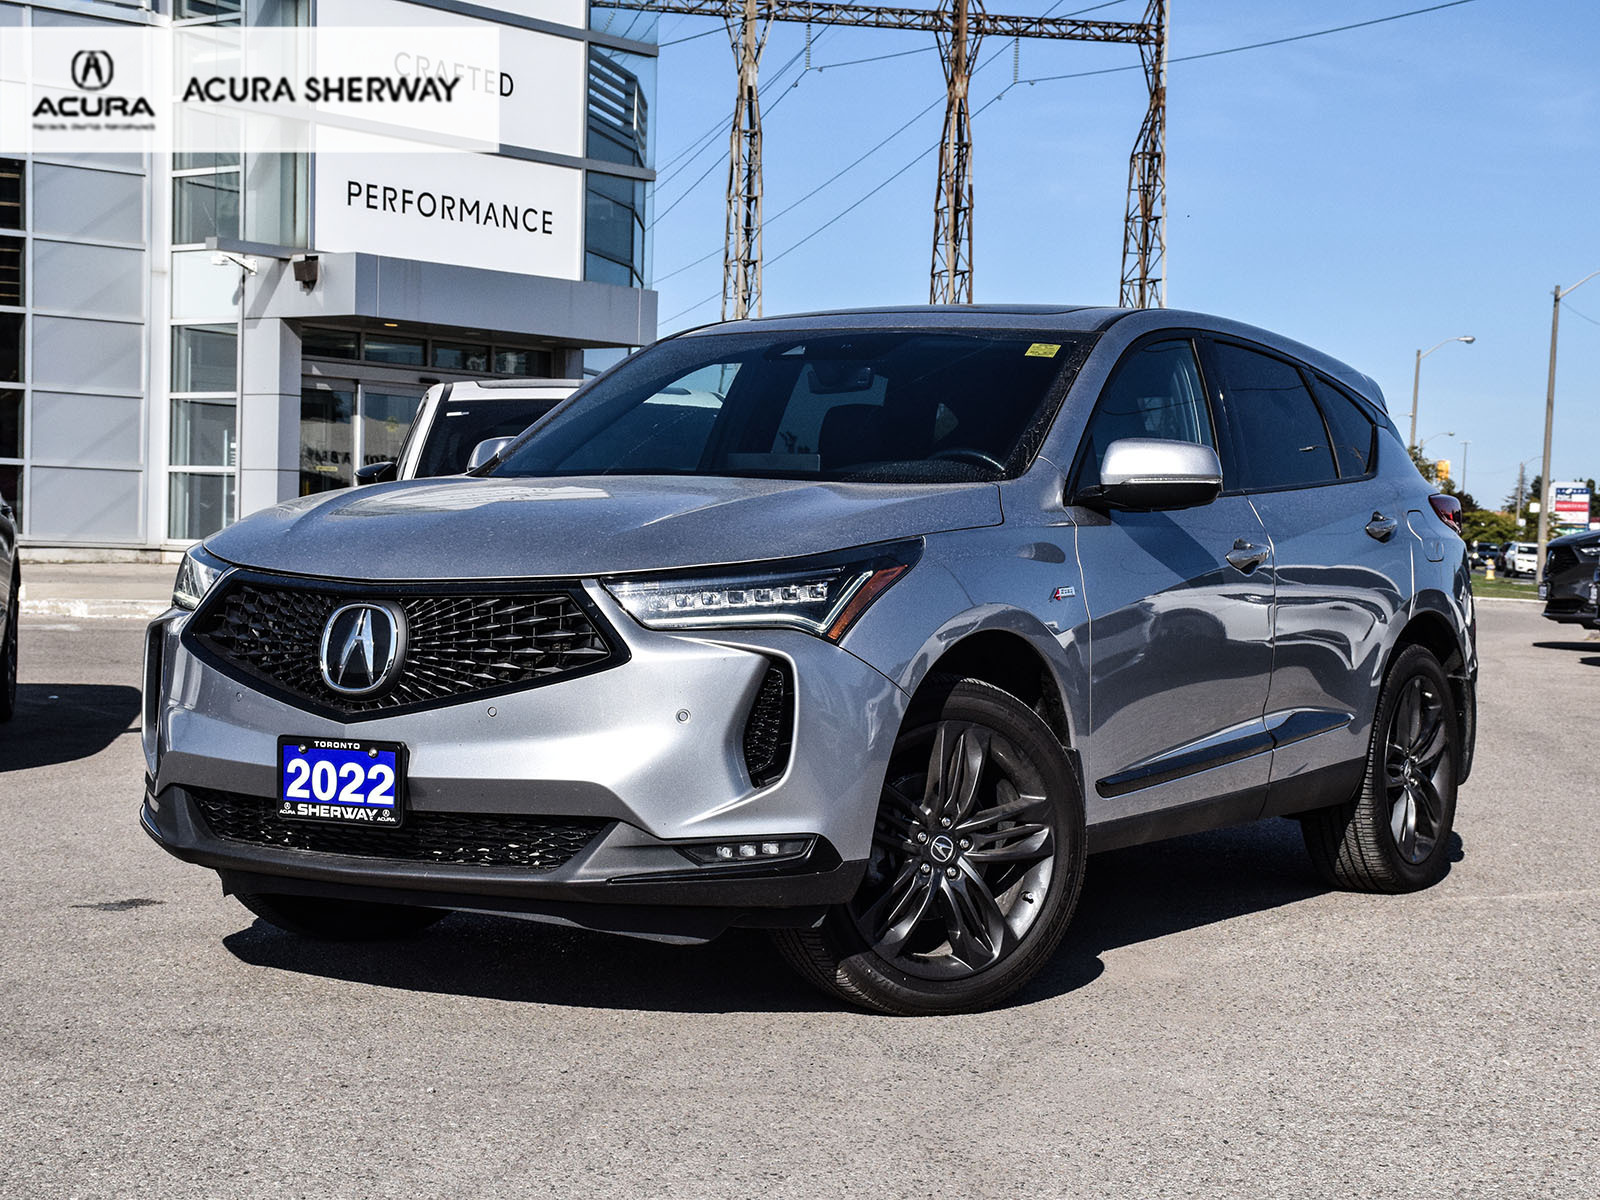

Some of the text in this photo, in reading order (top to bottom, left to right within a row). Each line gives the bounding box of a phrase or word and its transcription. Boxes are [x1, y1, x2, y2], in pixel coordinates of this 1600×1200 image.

[347, 180, 553, 235] PERFORMANCE
[314, 740, 361, 750] TORONTO
[286, 758, 395, 805] 2022
[297, 803, 379, 821] SHERWAY
